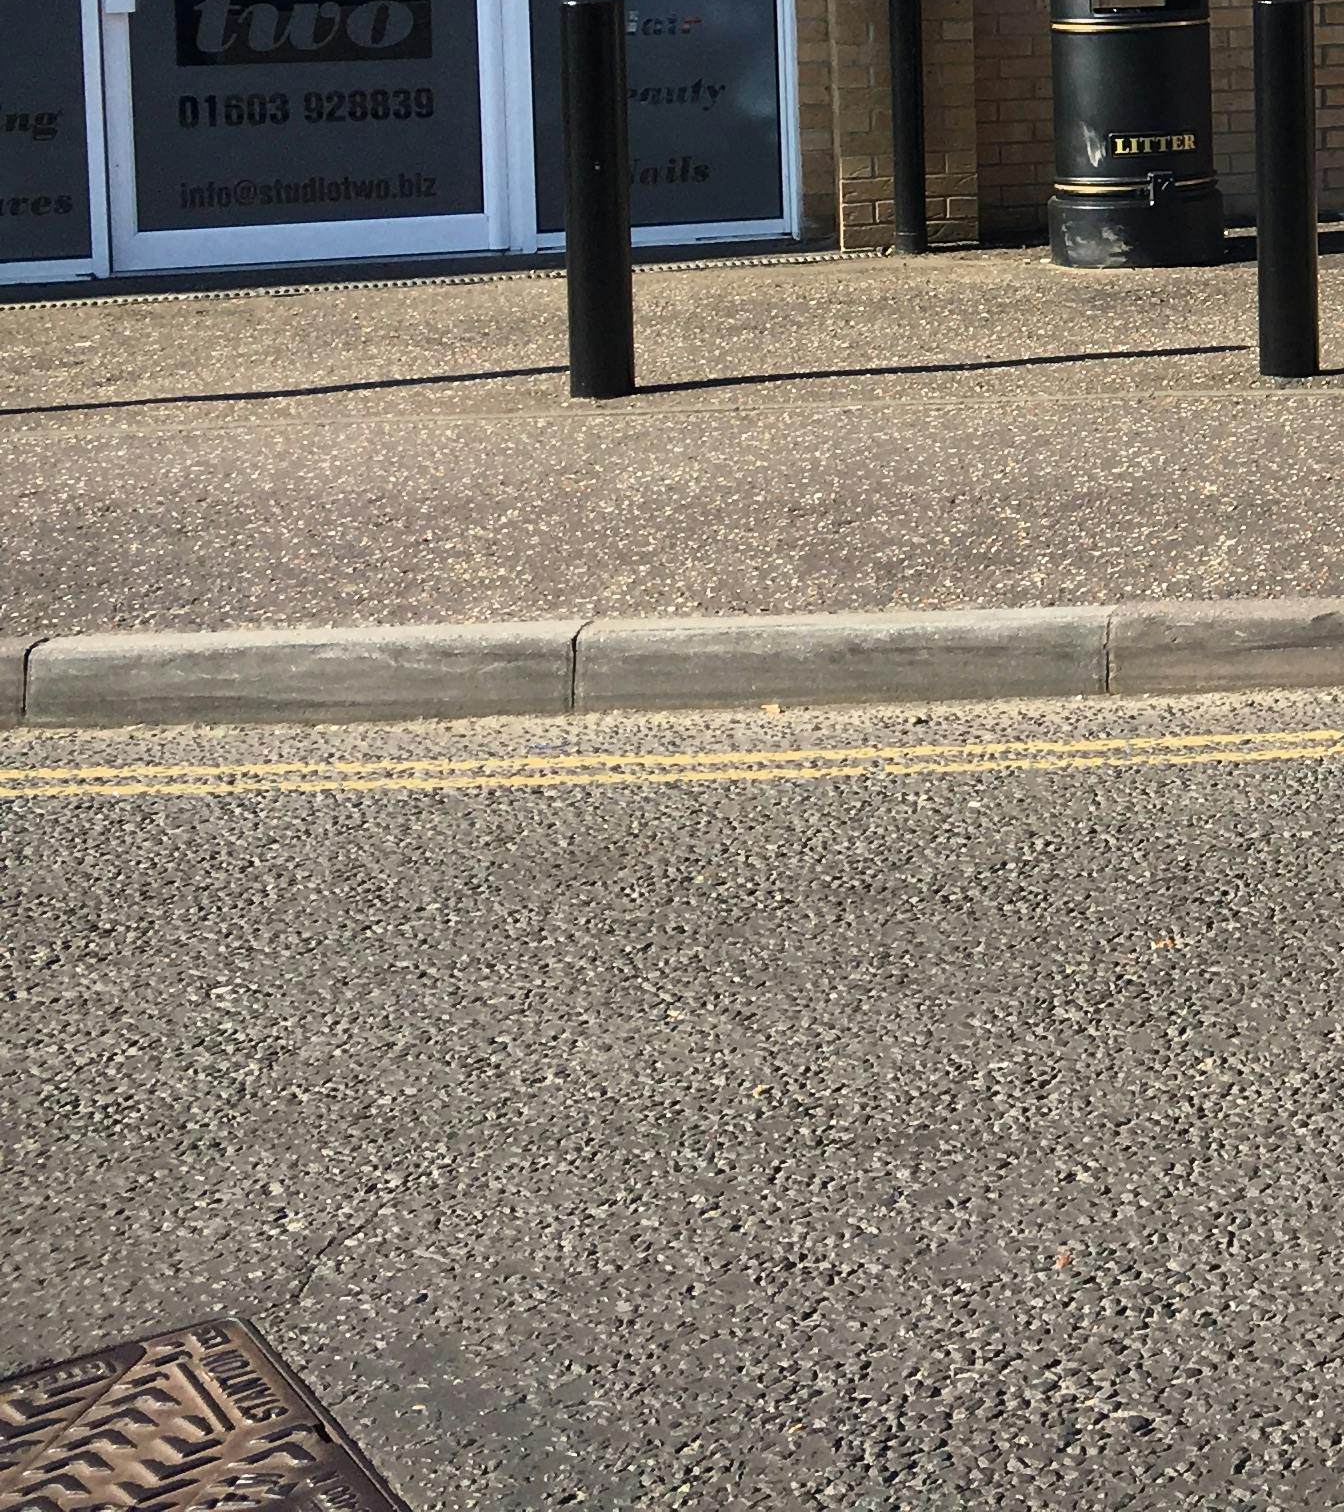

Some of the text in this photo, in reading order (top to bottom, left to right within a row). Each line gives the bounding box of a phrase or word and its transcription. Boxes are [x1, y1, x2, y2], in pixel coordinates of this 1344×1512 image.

[177, 87, 435, 129] 01603 928839
[1114, 134, 1196, 155] LITTER
[180, 172, 438, 210] info@studiotwo.biz
